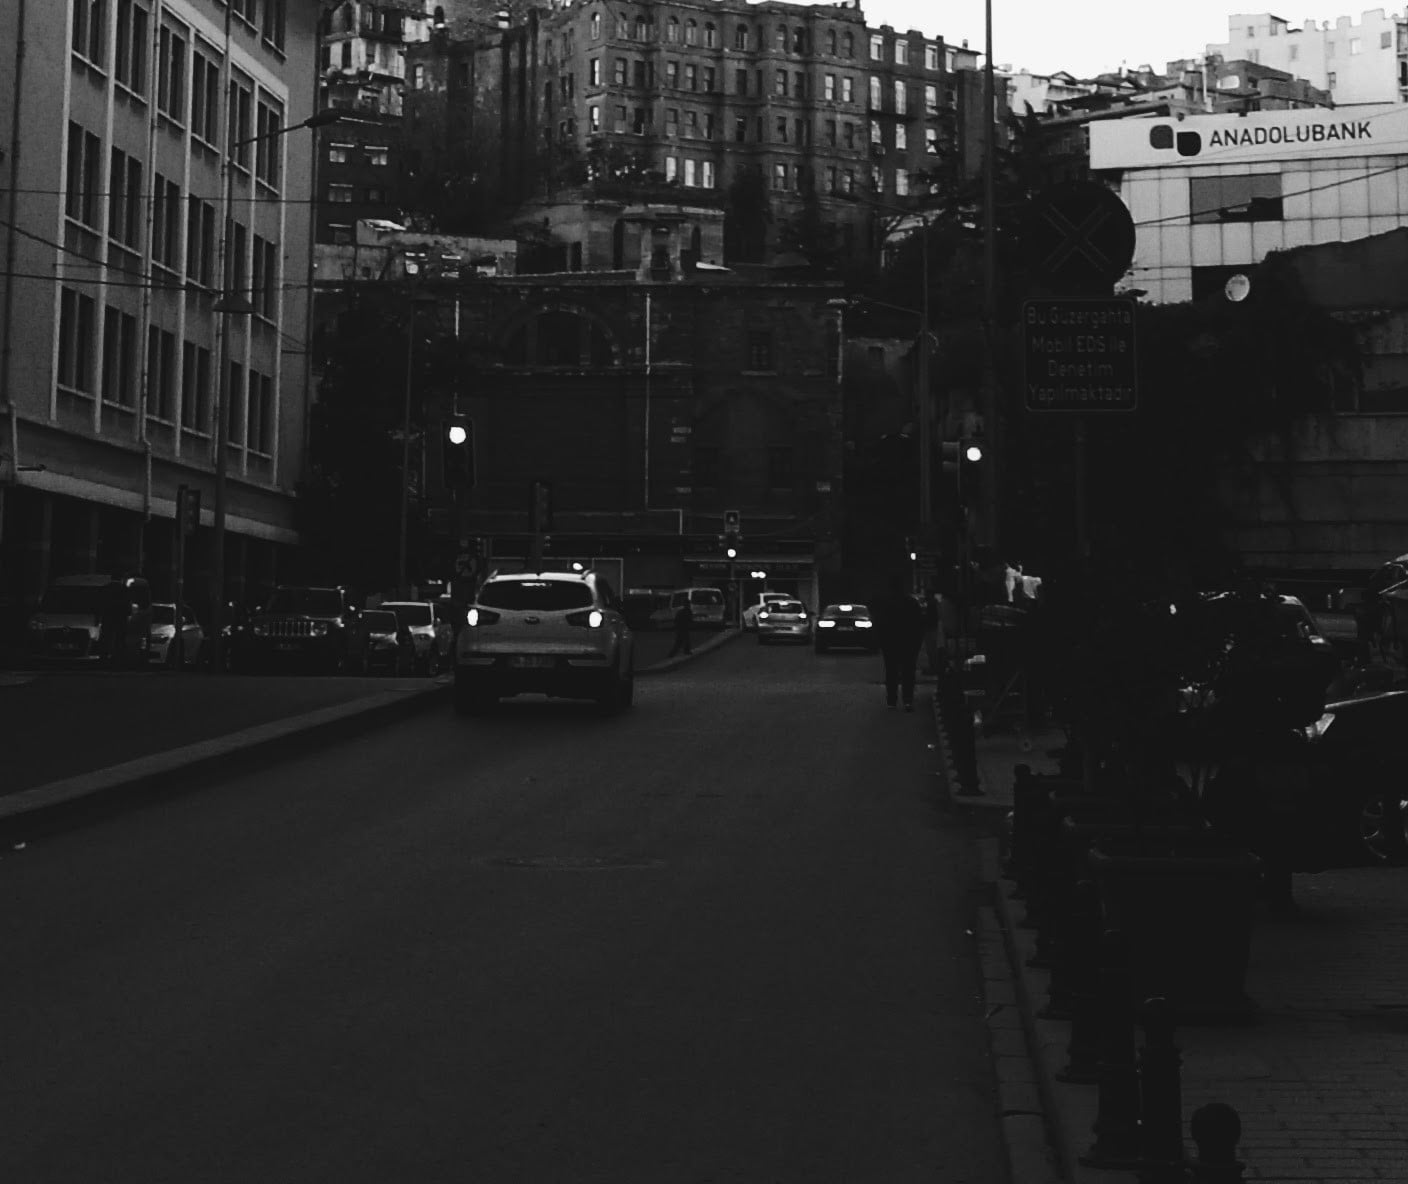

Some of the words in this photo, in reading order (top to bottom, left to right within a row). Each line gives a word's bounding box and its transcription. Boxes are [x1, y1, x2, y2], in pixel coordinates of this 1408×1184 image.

[1209, 121, 1373, 147] ANADOLUBANK
[1026, 305, 1046, 325] Bu
[1031, 335, 1072, 353] Mobil
[1076, 335, 1106, 353] EDS
[1047, 358, 1114, 377] Denetim
